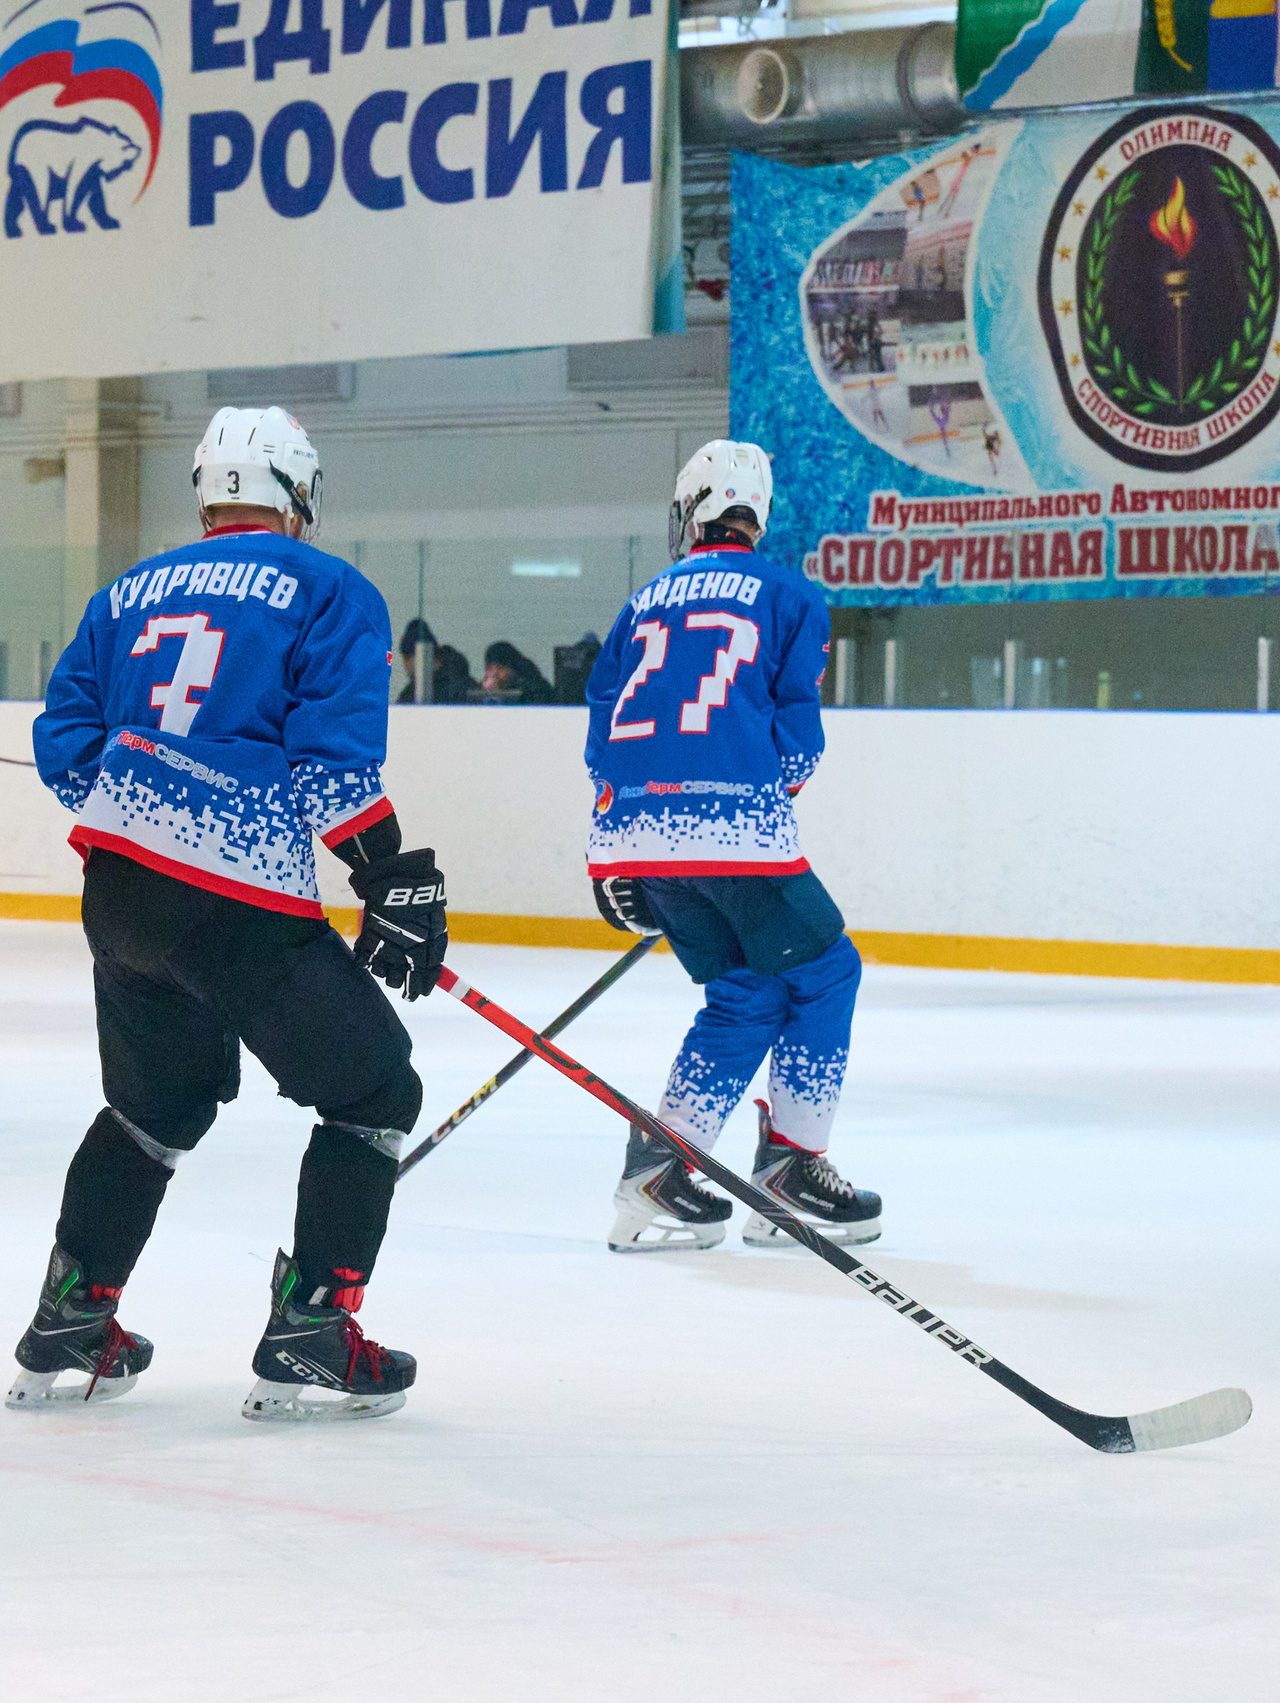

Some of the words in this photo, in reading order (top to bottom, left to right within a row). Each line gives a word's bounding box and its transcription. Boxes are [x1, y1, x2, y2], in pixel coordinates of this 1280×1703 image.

[188, 59, 652, 228] РОССИЯ
[1120, 119, 1233, 162] ОЛИМПИЯ
[1077, 377, 1201, 450] СПОРТИВНАЯ
[227, 470, 240, 494] 3
[871, 491, 1101, 532] Муниципального
[109, 561, 299, 620] КУДРЯВЦЕВ
[608, 611, 760, 742] 27
